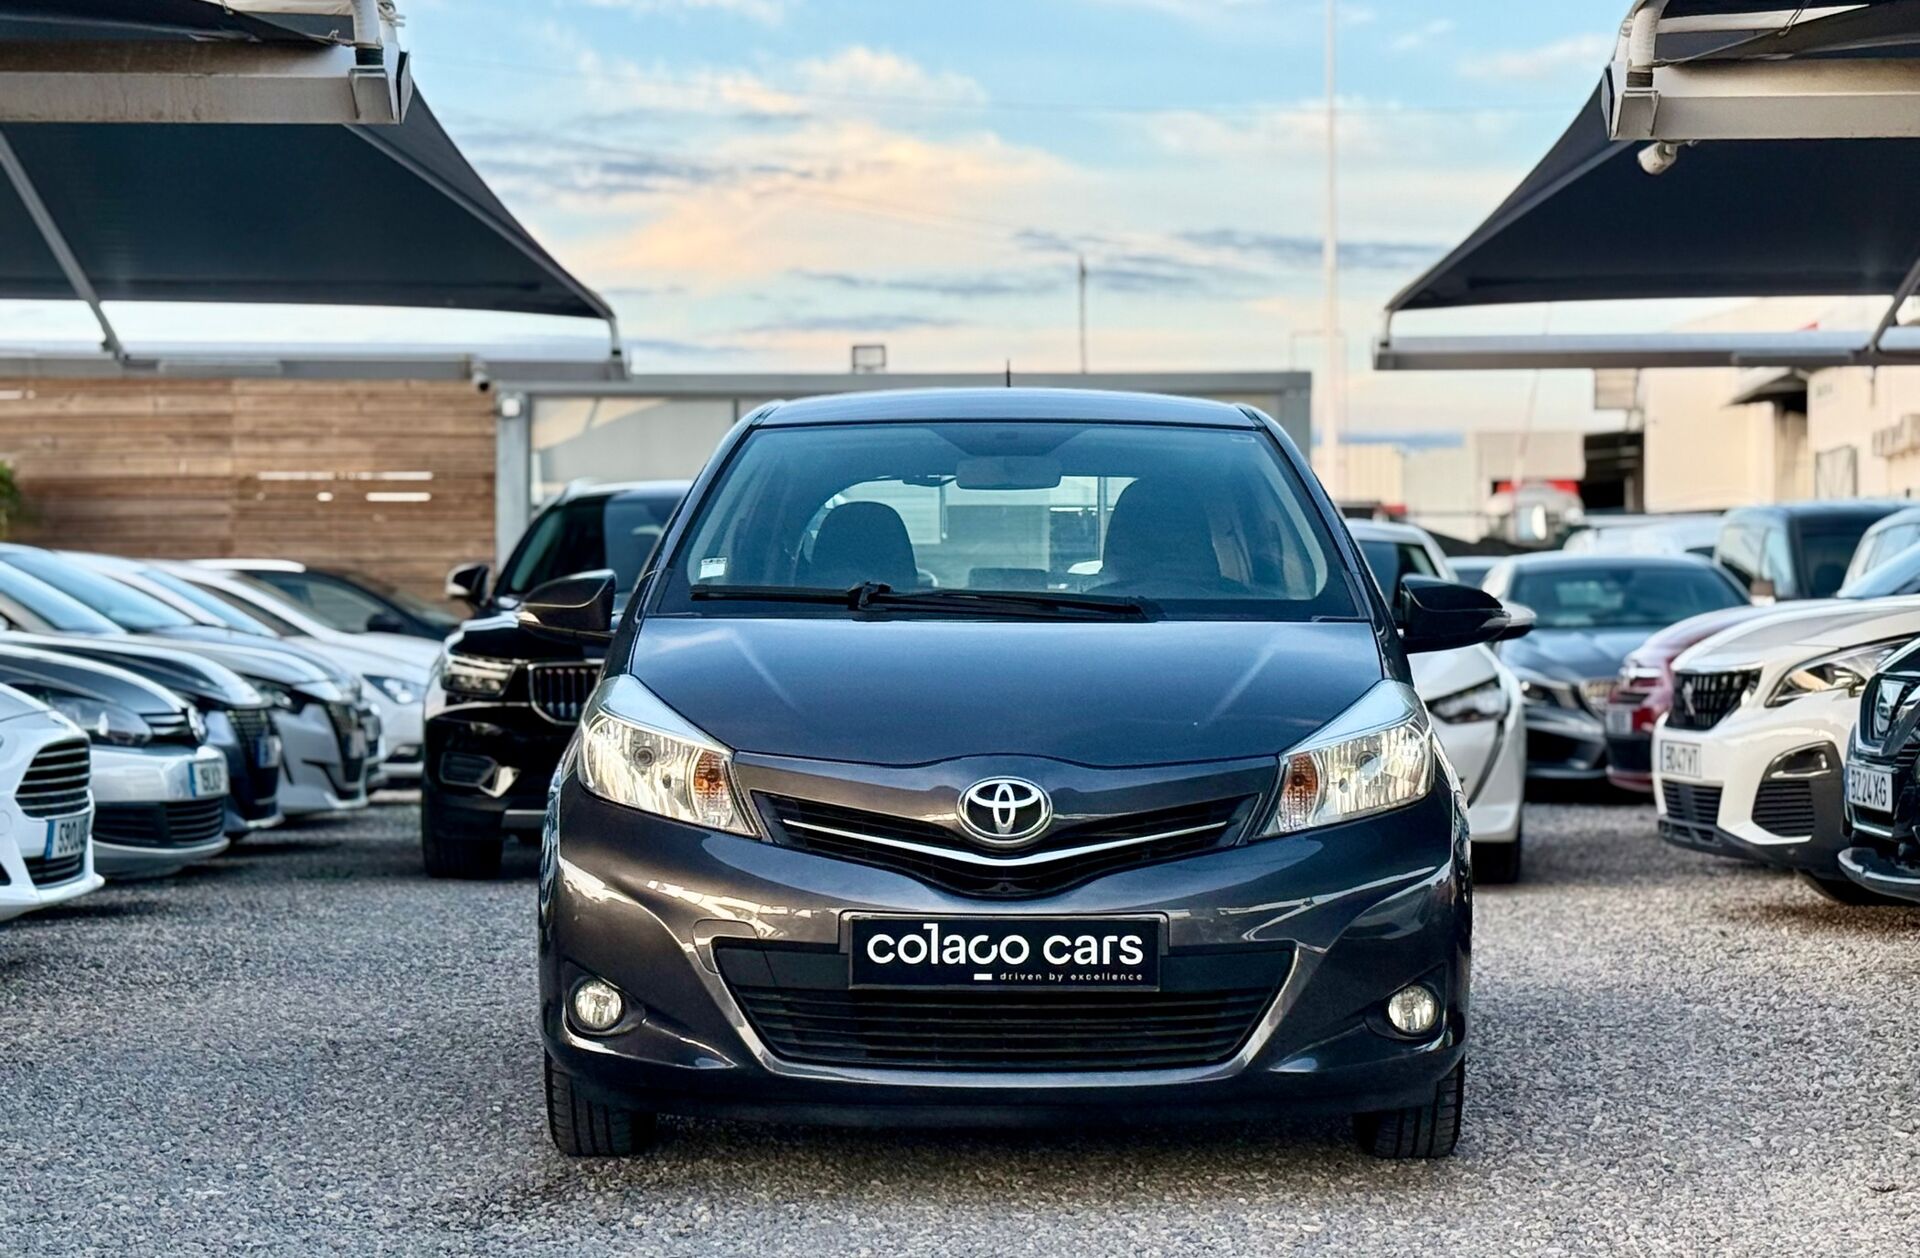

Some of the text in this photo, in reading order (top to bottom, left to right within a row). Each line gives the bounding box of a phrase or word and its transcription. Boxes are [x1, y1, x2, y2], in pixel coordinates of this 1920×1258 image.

[1042, 934, 1144, 966] cars
[999, 972, 1143, 983] driven by excellence
